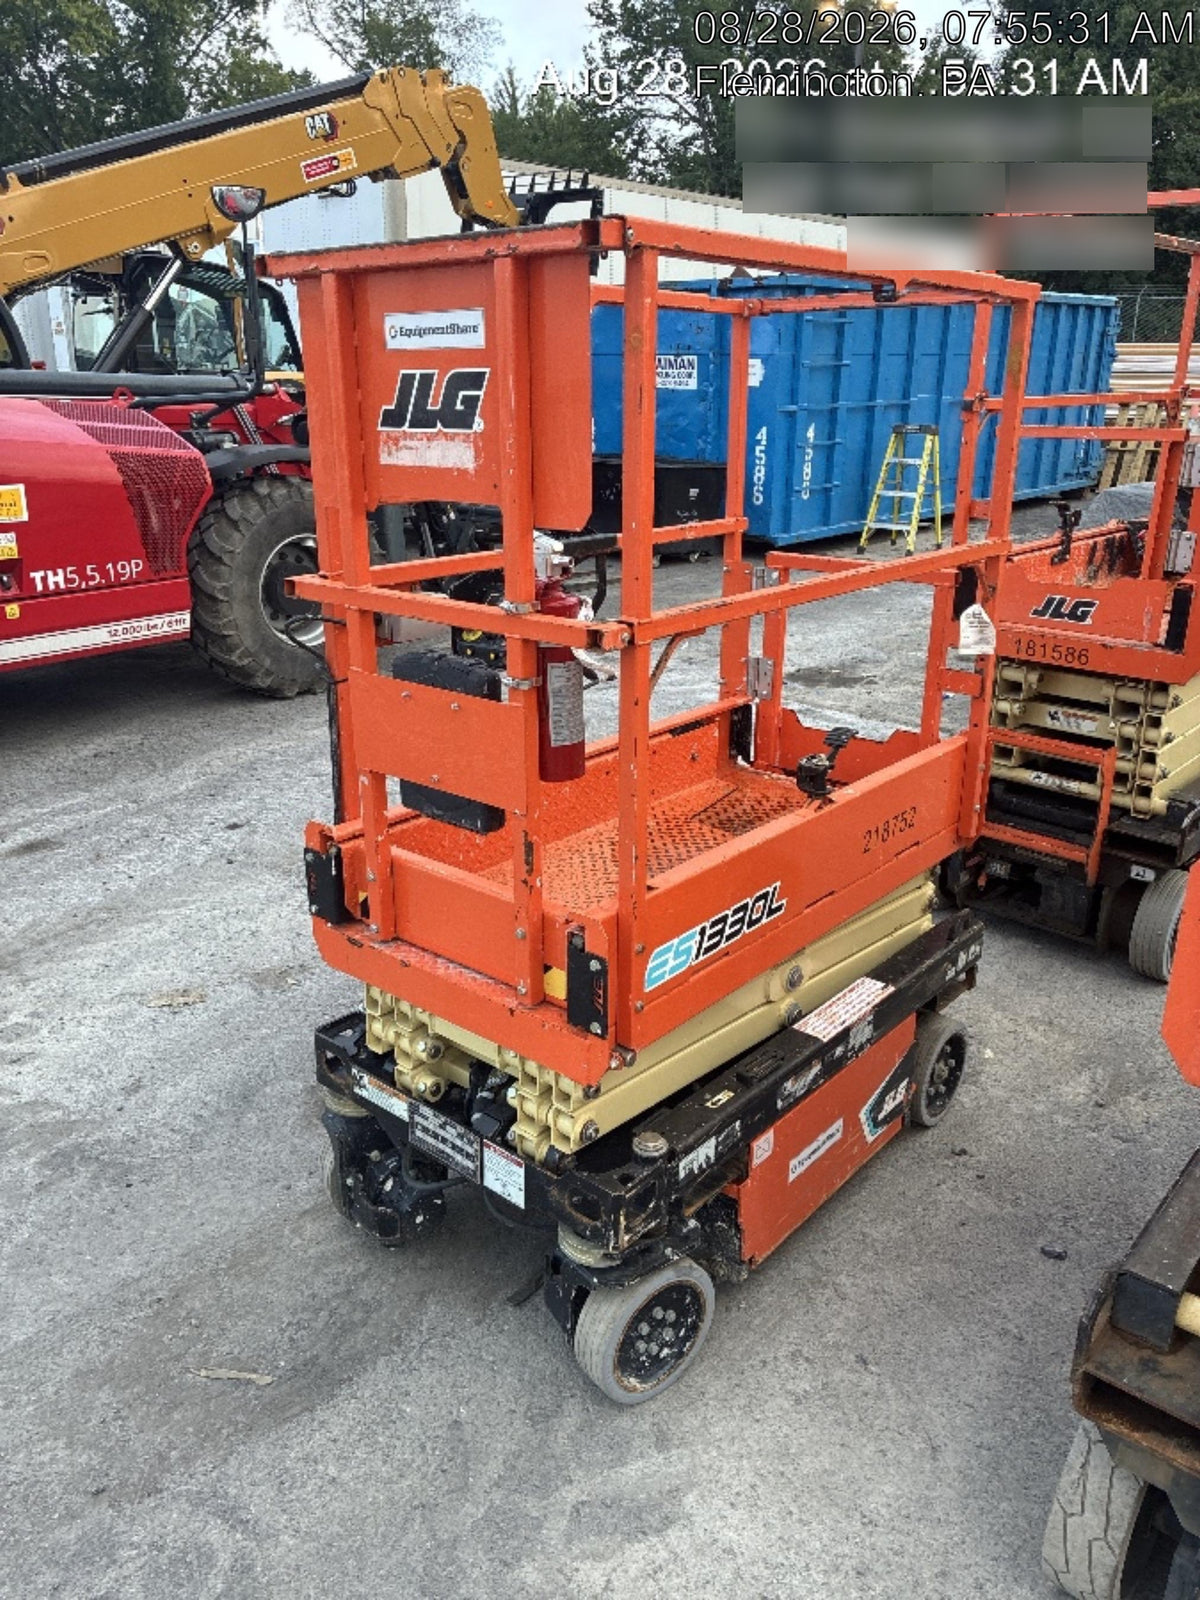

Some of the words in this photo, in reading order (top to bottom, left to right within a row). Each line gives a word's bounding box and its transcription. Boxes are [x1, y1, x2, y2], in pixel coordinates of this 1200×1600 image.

[304, 112, 333, 140] CAT
[399, 323, 480, 340] EquipmentShare
[377, 368, 491, 432] JLG
[1029, 595, 1099, 624] JLG
[1014, 638, 1090, 665] 181586
[863, 806, 918, 854] 218752
[644, 880, 788, 993] ES1330L
